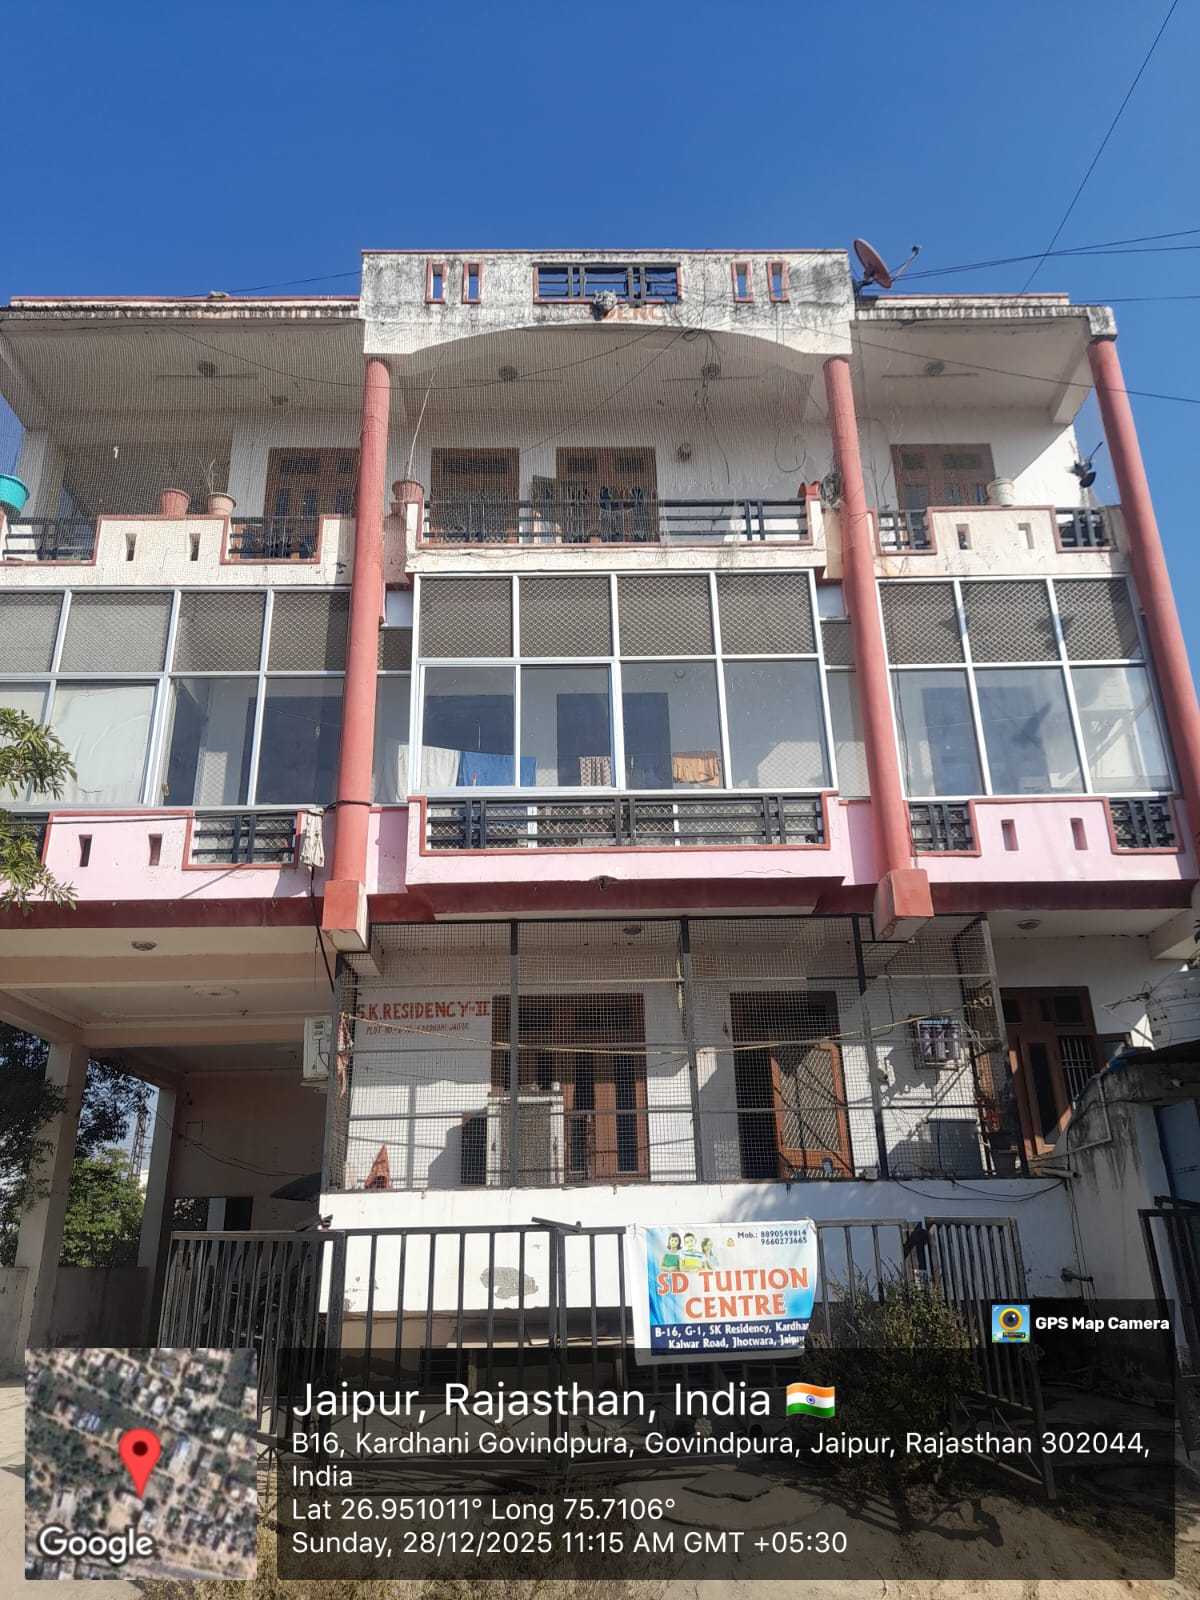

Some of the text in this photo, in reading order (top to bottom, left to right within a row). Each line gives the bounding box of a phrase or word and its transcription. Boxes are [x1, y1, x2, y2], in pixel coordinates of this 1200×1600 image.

[657, 1267, 809, 1296] SD TUITION
[685, 1293, 787, 1319] CENTRE
[655, 1326, 682, 1338] B-16,
[685, 1325, 706, 1337] G-1,
[709, 1324, 722, 1335] SK
[725, 1322, 772, 1334] Residency,
[668, 1339, 700, 1349] Kalwar
[703, 1337, 729, 1349] Road,
[732, 1336, 777, 1348] Jhotwara,
